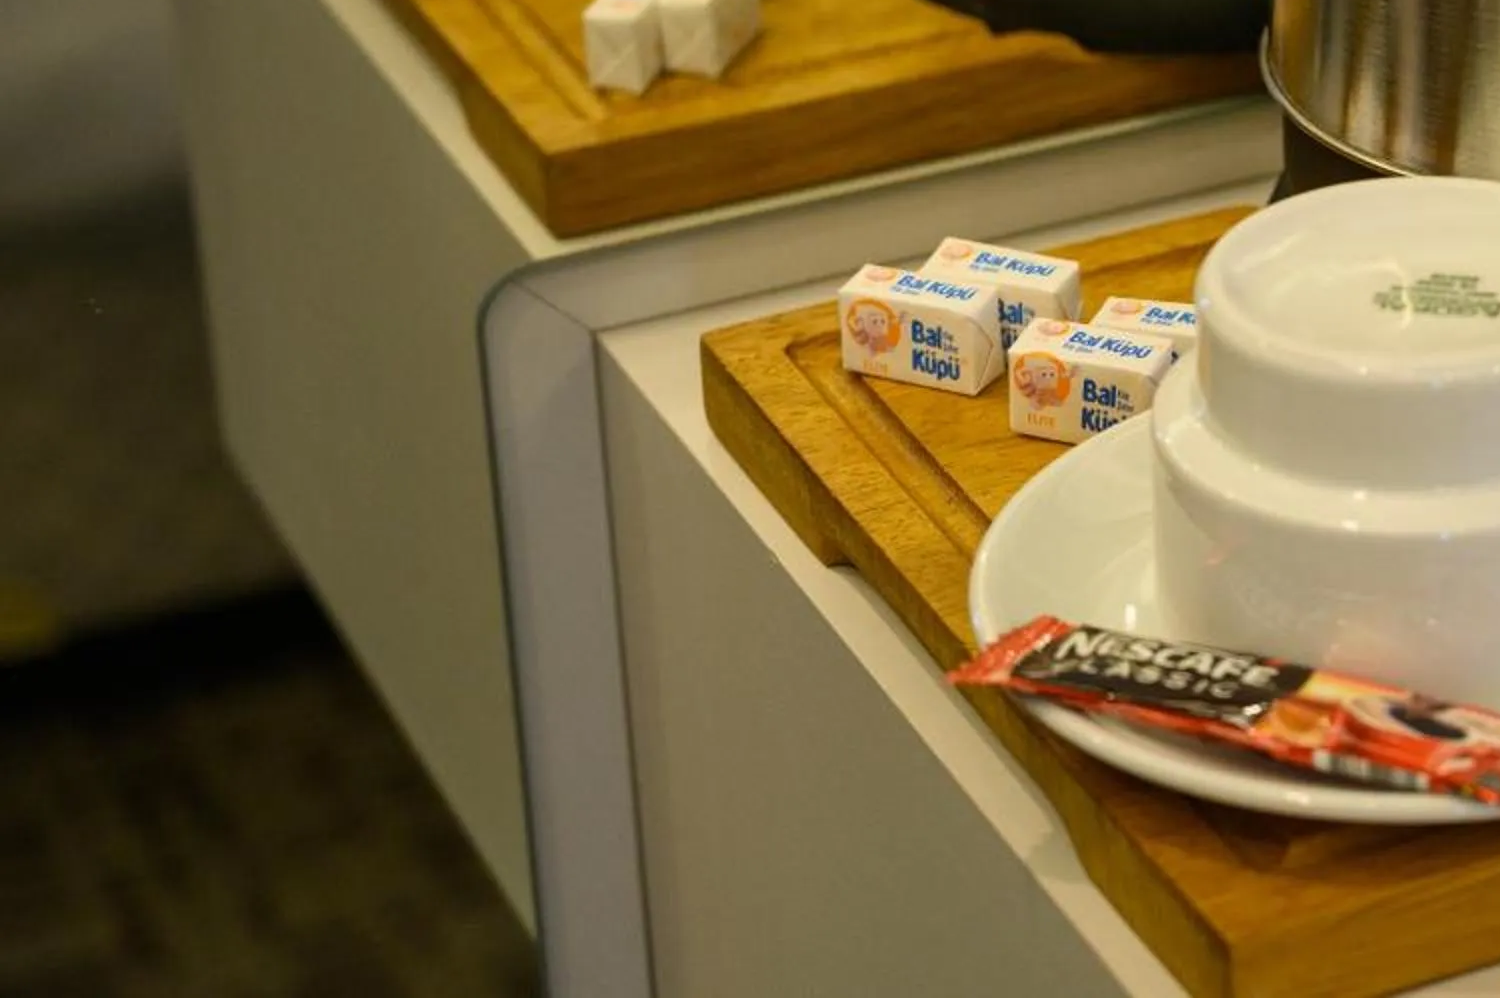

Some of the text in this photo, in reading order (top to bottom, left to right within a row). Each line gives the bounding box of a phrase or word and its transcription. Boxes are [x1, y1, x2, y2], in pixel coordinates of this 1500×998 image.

[974, 252, 1007, 266] Bal
[897, 274, 929, 290] Bal
[911, 319, 942, 348] Bal
[1069, 331, 1103, 347] Bal
[1100, 338, 1152, 358] Küpü
[911, 348, 960, 380] Küpü
[1083, 378, 1116, 408] Bal
